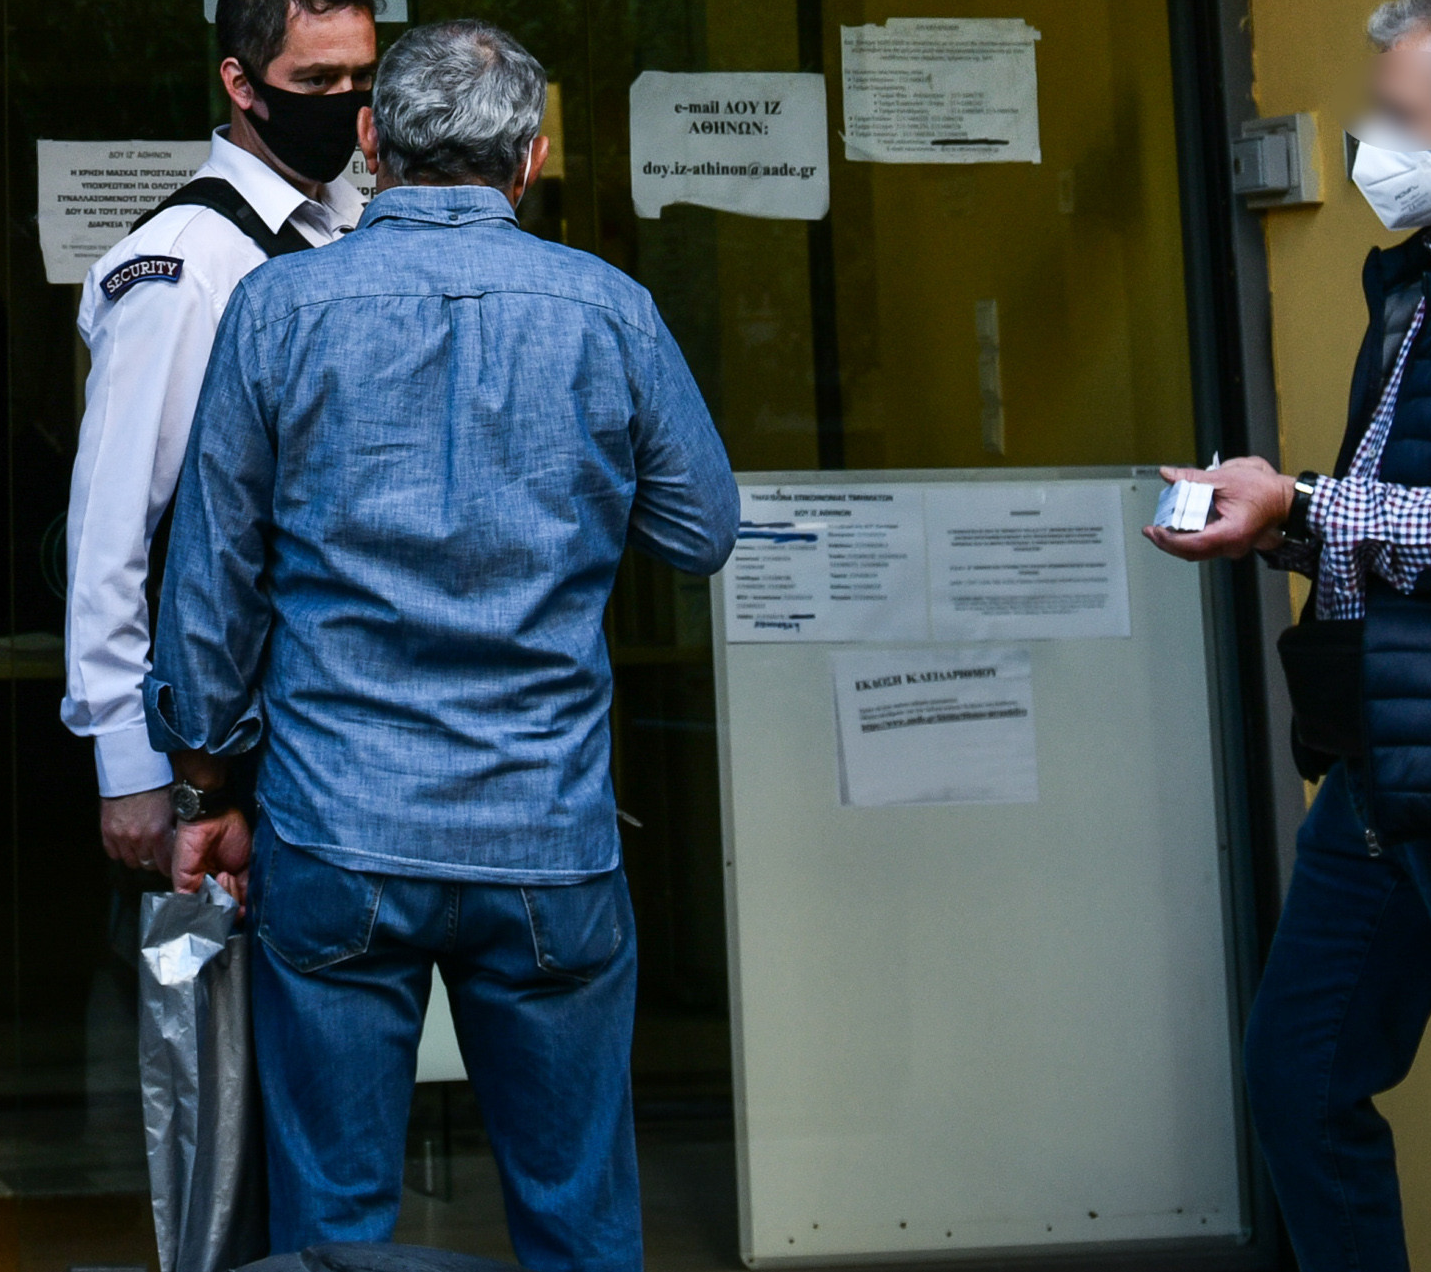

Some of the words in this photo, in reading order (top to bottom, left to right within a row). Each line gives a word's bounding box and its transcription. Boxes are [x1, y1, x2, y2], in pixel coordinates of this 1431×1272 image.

[674, 100, 720, 114] e-mail
[724, 101, 759, 115] ΔΟΥ
[764, 101, 782, 115] ΙΖ
[688, 120, 769, 135] ΑΘΗΝΩΝ:
[642, 161, 817, 180] doy.iz-athinon@aade.gr
[106, 260, 178, 293] SECURITY
